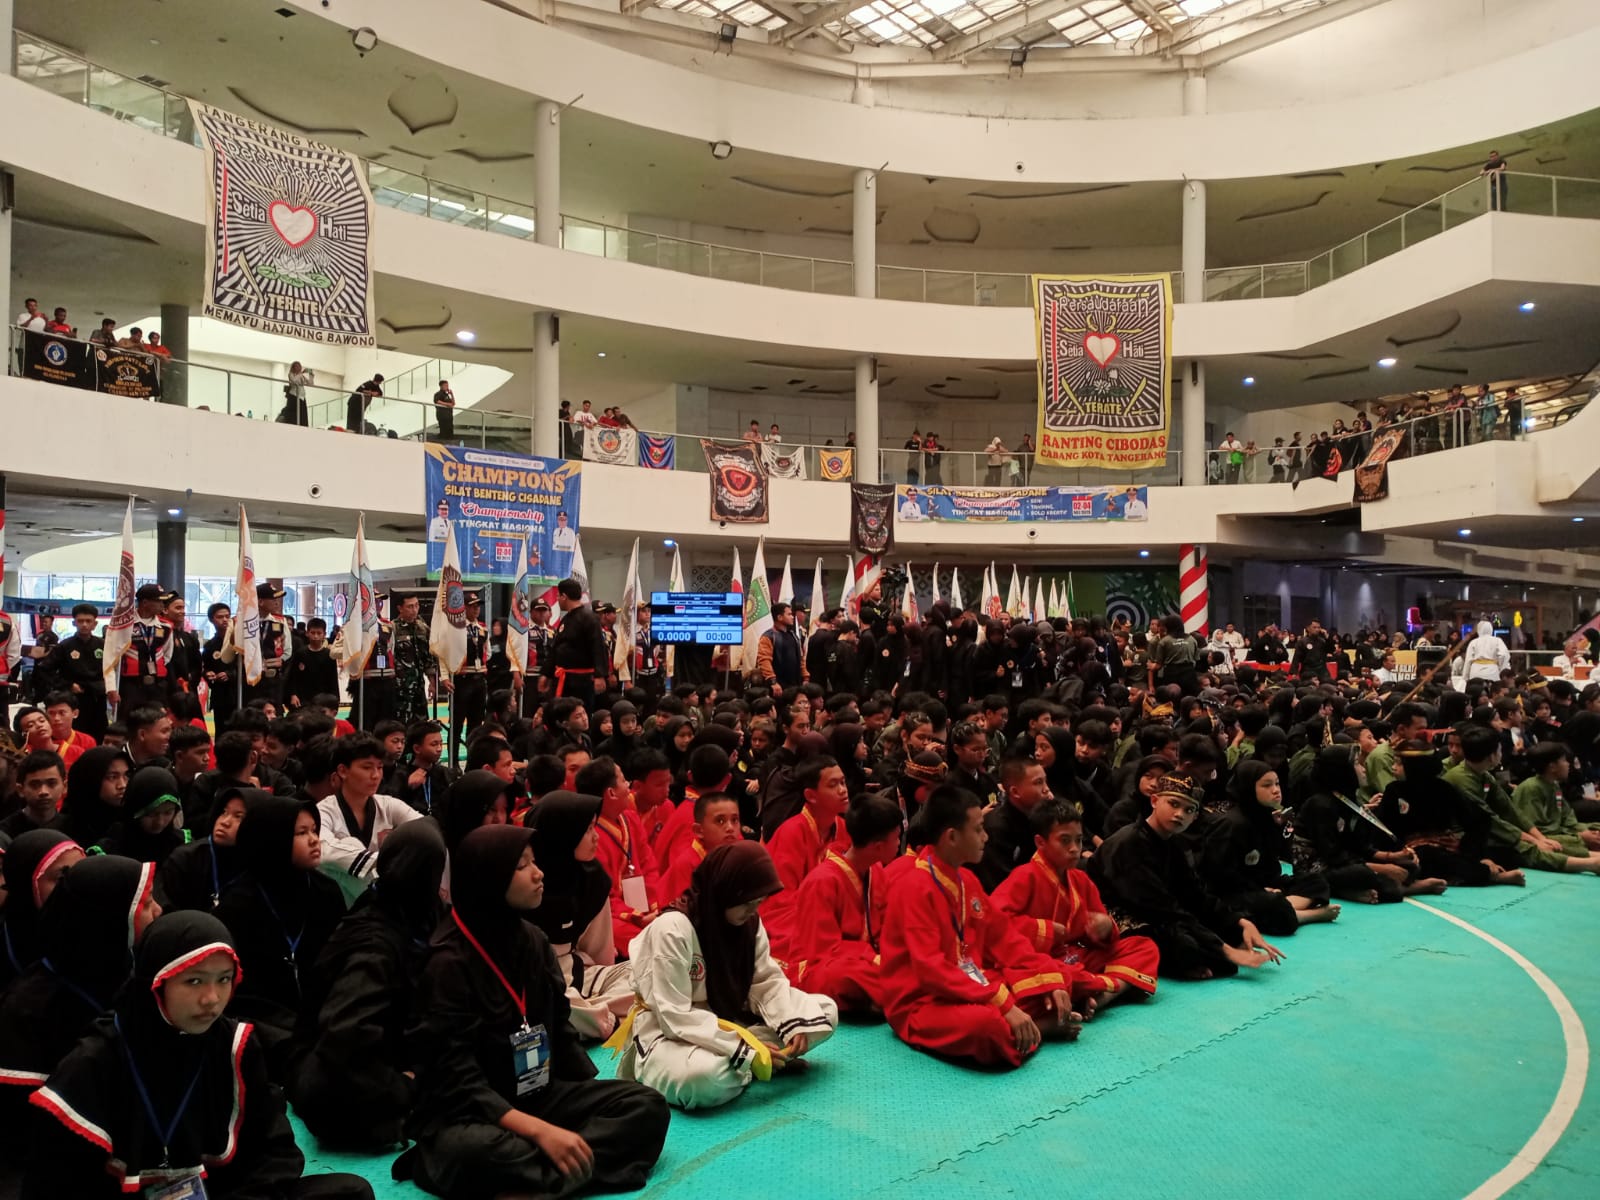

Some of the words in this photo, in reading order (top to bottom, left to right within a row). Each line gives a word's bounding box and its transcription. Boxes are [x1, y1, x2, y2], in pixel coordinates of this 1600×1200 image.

[203, 105, 301, 145] TANGERANG
[231, 190, 267, 223] Setia
[320, 215, 348, 240] Hati
[267, 293, 320, 315] TERATE
[204, 305, 259, 328] MEMAYU
[262, 320, 323, 341] HAYUNING
[326, 332, 375, 347] BAWONO
[1085, 402, 1122, 415] TERATE
[1042, 434, 1102, 449] RANTING
[1105, 435, 1166, 451] CIBODAS
[1041, 449, 1079, 460] CABANG
[1081, 450, 1104, 460] KOTA
[1107, 451, 1167, 462] TANGERANG
[442, 461, 566, 493] CHAMPIONS
[444, 485, 473, 497] SILAT
[474, 487, 517, 501] BENTENG
[519, 492, 562, 506] CISADANE
[460, 502, 544, 523] Championship
[459, 519, 500, 530] TINGKAT
[658, 632, 691, 641] 0.0000
[706, 632, 732, 641] 00:00
